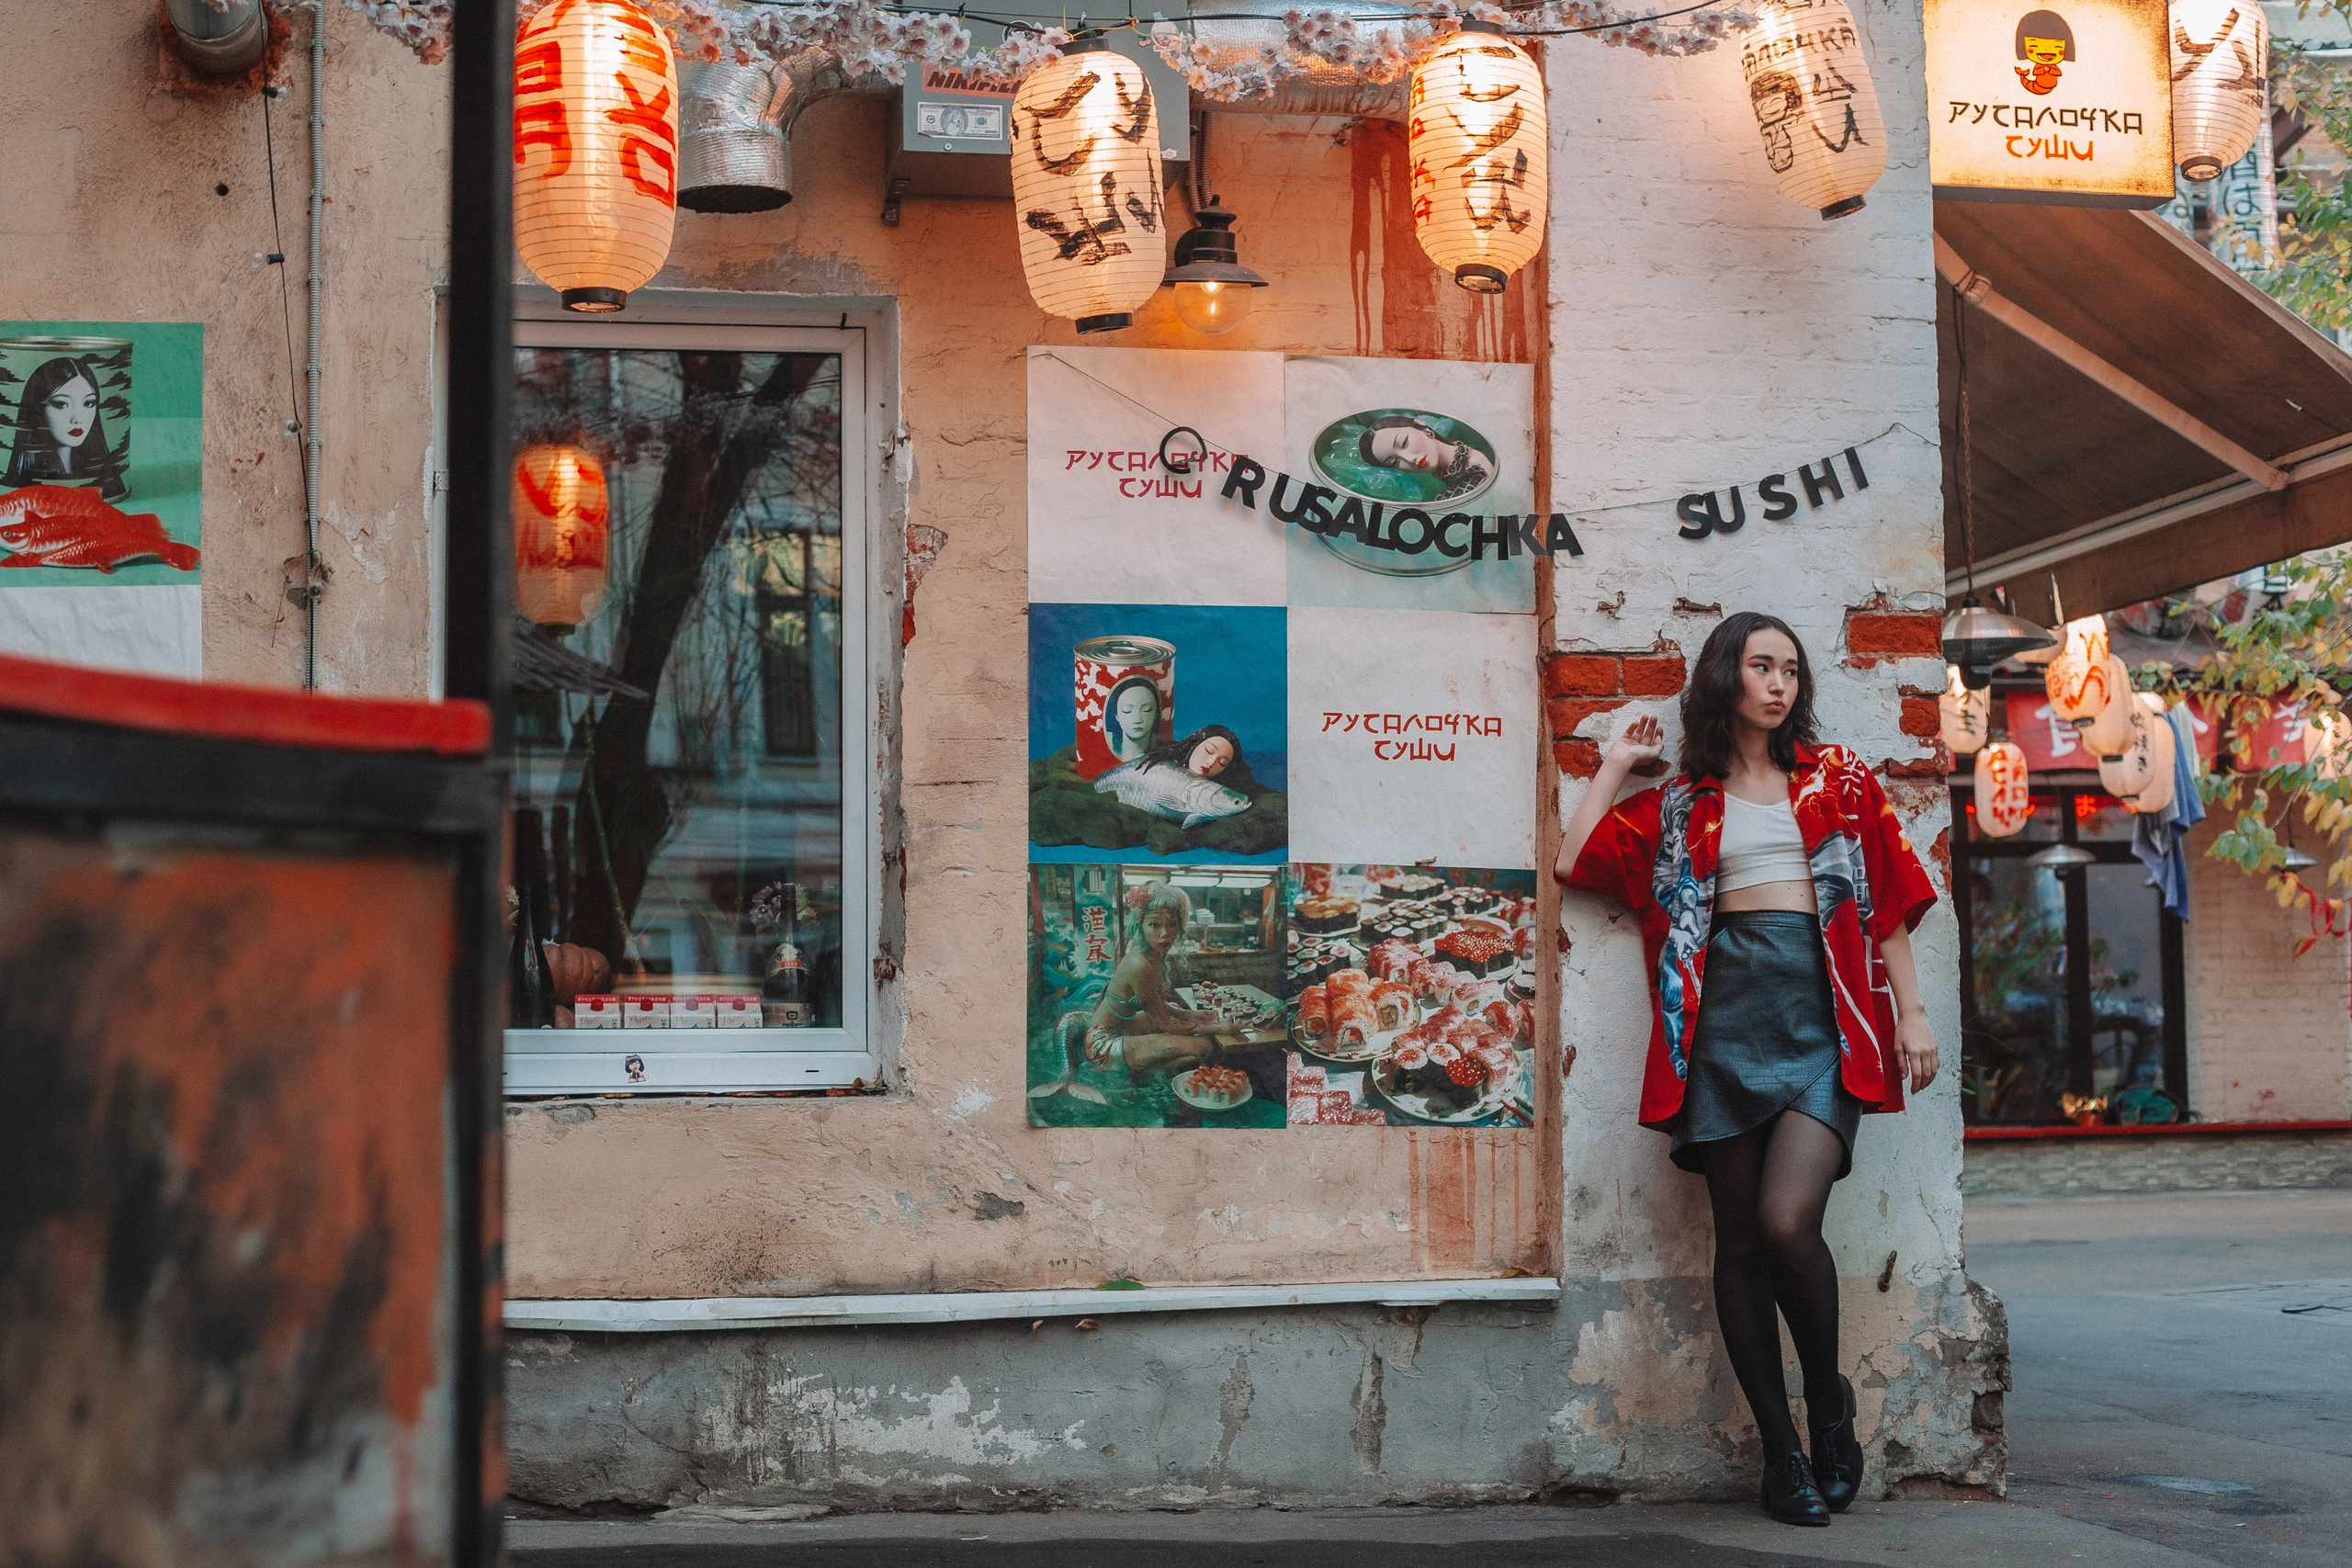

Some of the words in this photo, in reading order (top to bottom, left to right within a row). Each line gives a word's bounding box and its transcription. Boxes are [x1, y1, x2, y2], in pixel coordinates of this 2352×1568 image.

[1948, 101, 2143, 135] РУСАЛОЧКА
[2006, 133, 2094, 162] СУШИ
[1119, 475, 1203, 499] СУШИ
[1220, 455, 1585, 561] RUSALOCHKA
[1677, 446, 1870, 540] SUSHI
[1321, 711, 1502, 738] РУСАЛОЧКА
[1374, 738, 1456, 761] СУШИ
